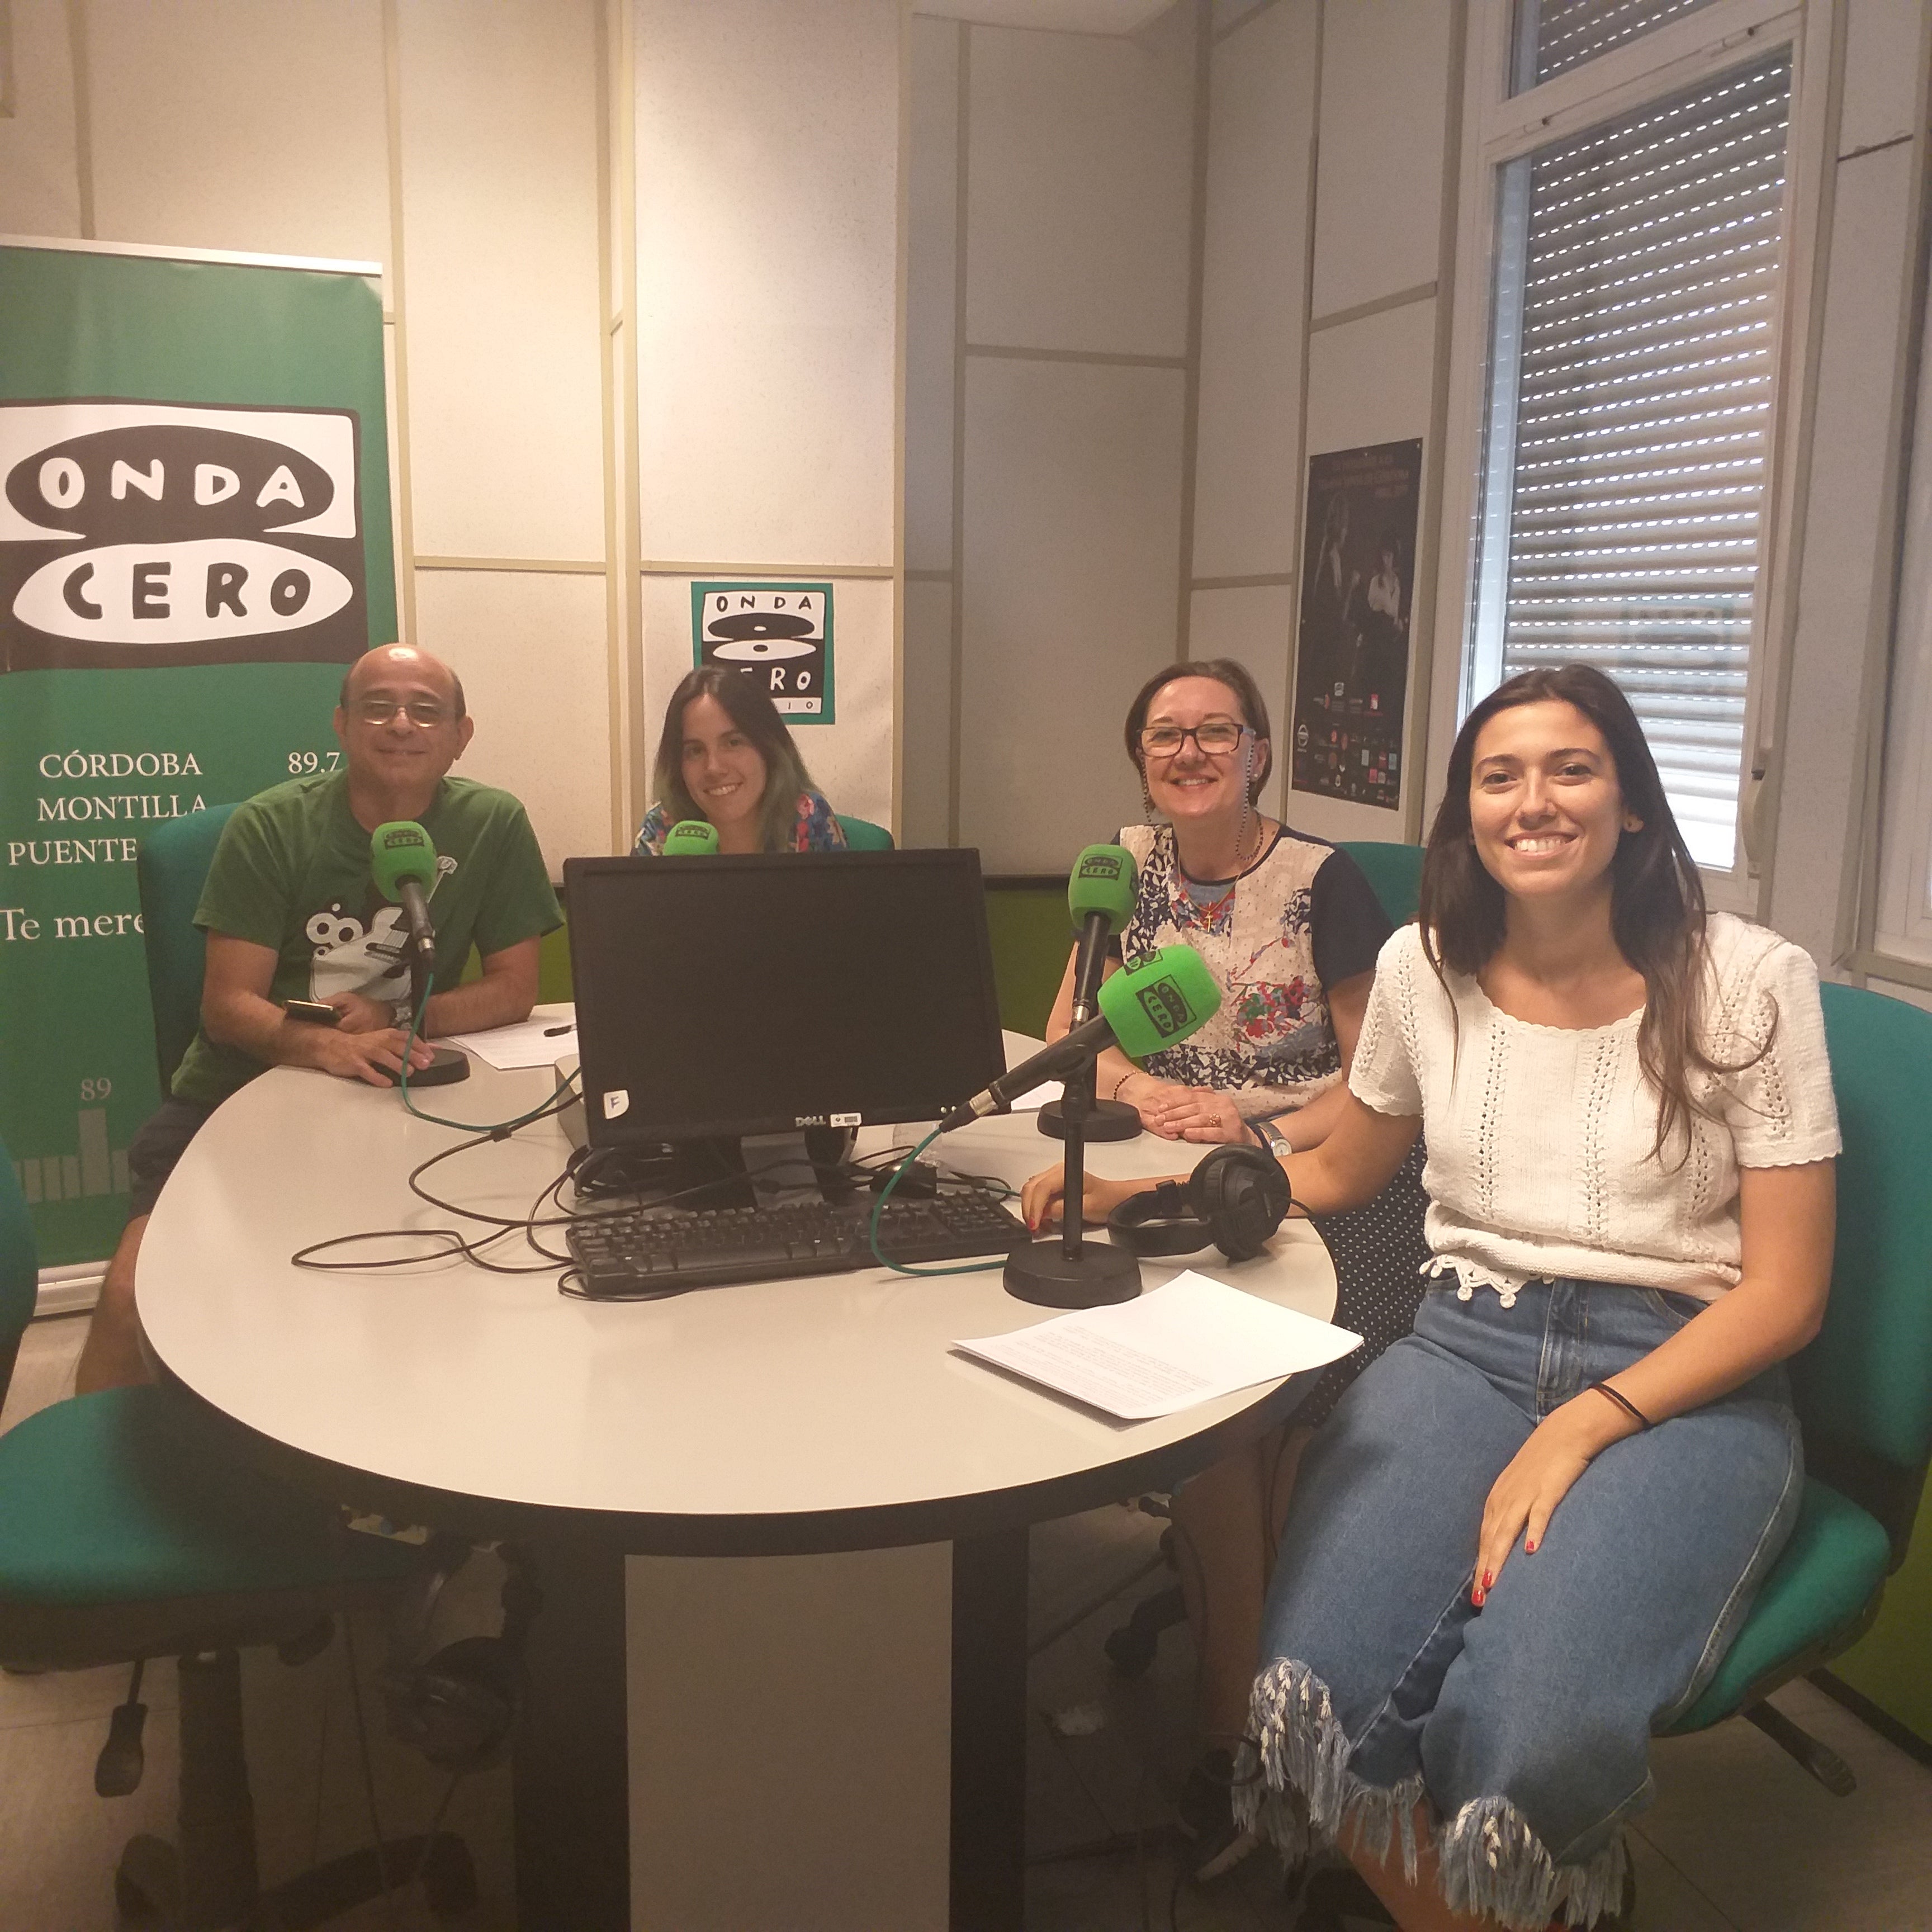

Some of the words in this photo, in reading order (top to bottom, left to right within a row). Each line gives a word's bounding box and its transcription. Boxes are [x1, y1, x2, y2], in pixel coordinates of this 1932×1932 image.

[39, 457, 305, 509] ONDA
[63, 562, 311, 619] CERO
[716, 595, 812, 612] ONDA
[740, 666, 811, 690] RO
[39, 749, 203, 779] CÓRDOBA
[288, 751, 340, 774] 89.7
[37, 793, 207, 822] MONTILLA
[7, 837, 138, 866] PUENTE
[0, 908, 41, 941] Te
[1148, 996, 1172, 1028] CERO
[80, 1078, 112, 1101] 89
[610, 1096, 620, 1109] F
[795, 1115, 826, 1127] DELL
